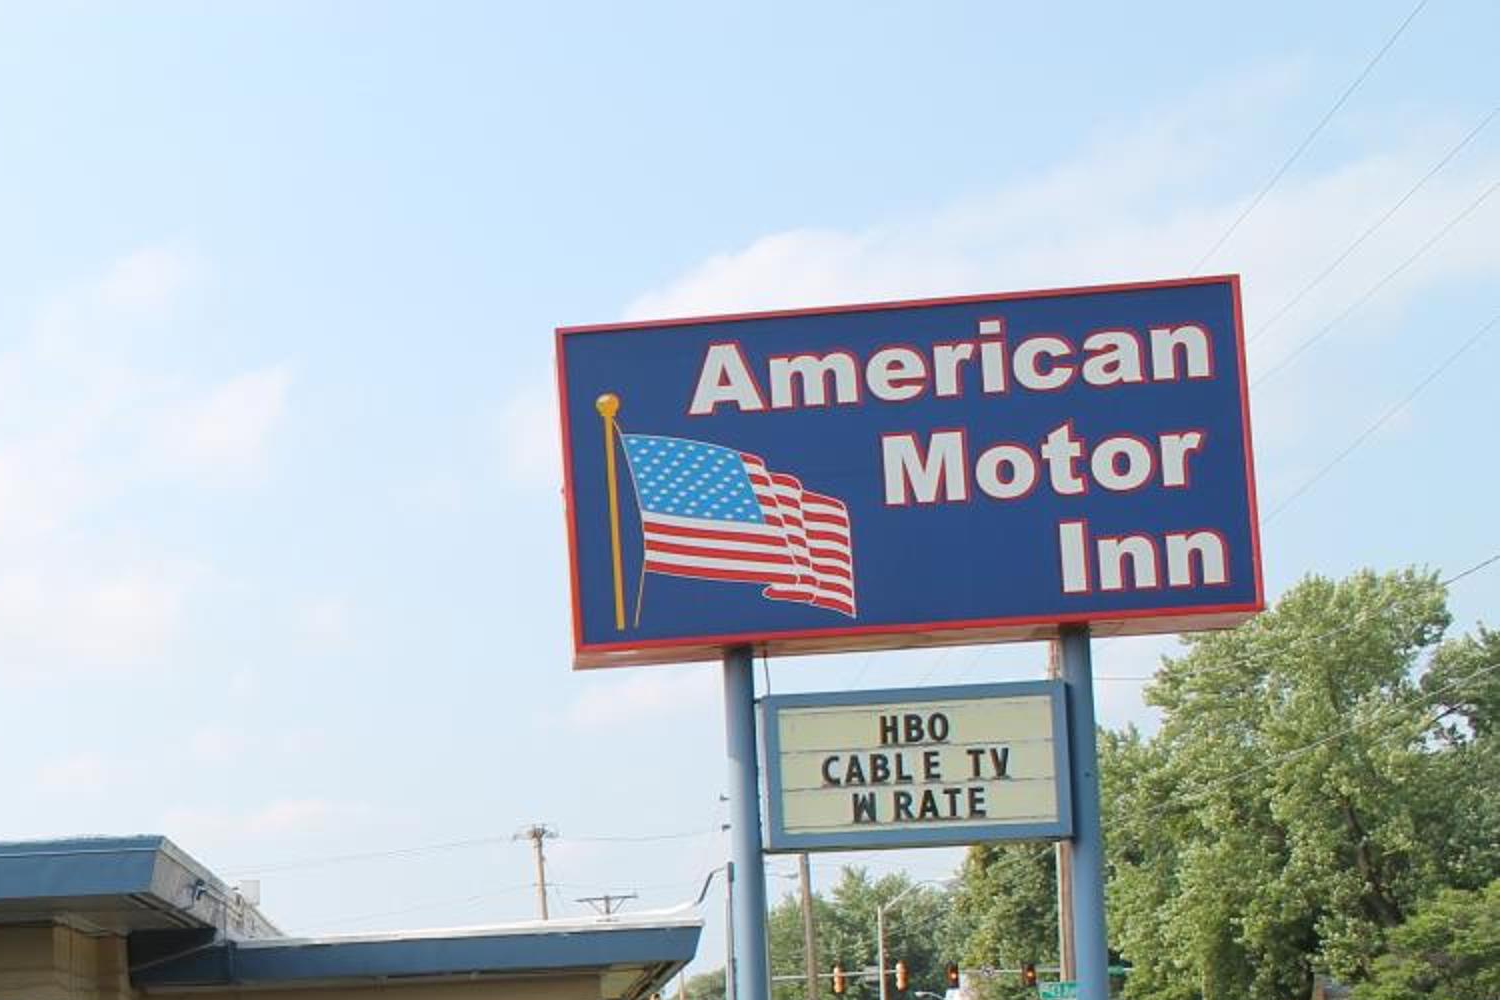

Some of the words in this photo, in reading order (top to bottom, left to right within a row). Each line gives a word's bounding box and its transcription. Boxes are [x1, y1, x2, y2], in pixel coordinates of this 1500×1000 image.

[689, 318, 1212, 415] American
[881, 420, 1203, 506] Motor
[1058, 520, 1229, 594] Inn
[879, 712, 949, 744] HBO
[821, 751, 941, 785] CABLE
[967, 747, 1010, 778] TV
[893, 787, 987, 821] RATE
